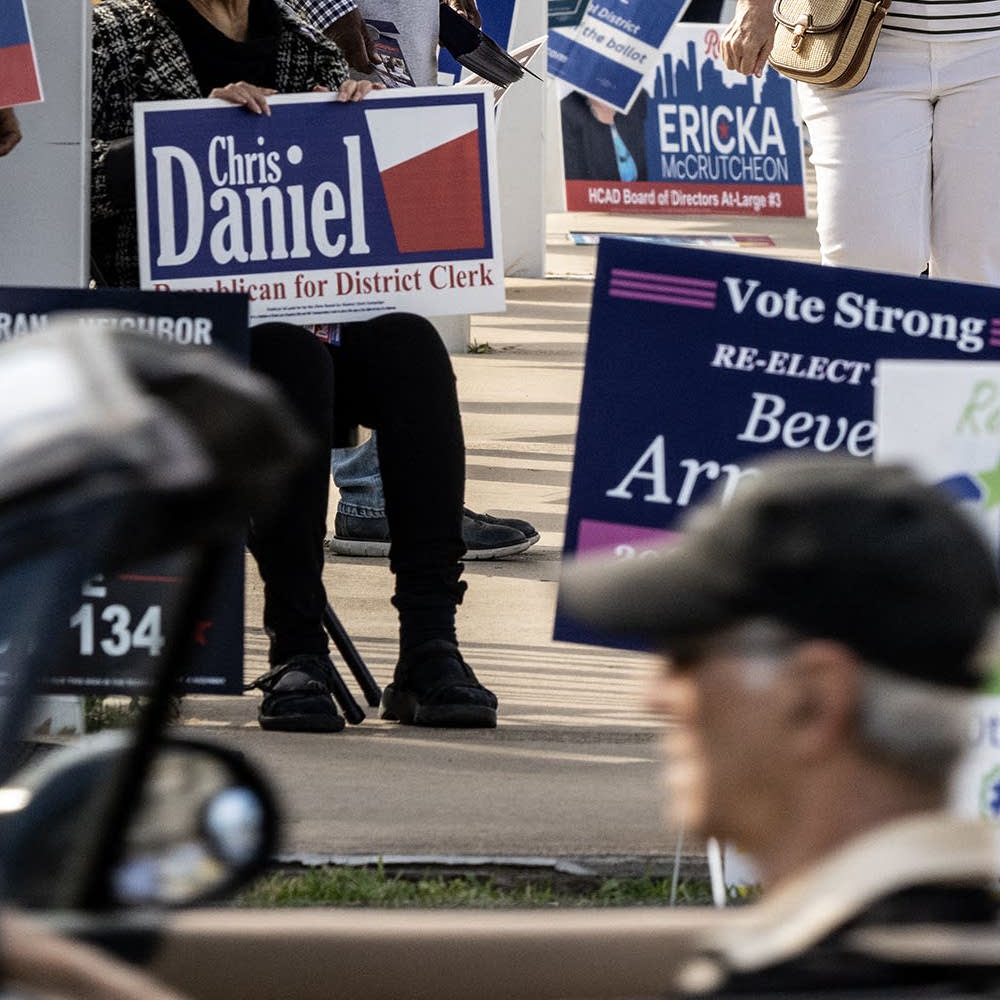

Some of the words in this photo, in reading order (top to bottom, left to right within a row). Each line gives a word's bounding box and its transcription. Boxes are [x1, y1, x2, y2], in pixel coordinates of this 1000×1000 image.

[582, 26, 605, 43] the
[606, 37, 648, 64] ballot
[597, 6, 641, 35] District
[658, 103, 786, 155] ERICKA
[208, 135, 281, 187] Chris
[661, 154, 790, 182] McCRUTCHEON
[151, 135, 370, 267] Daniel
[588, 188, 621, 205] HCAD
[623, 189, 655, 205] Board
[658, 189, 670, 205] of
[671, 190, 720, 207] Directors
[721, 190, 766, 211] At-Large
[767, 192, 782, 208] #3
[295, 274, 329, 298] for
[336, 267, 421, 297] District
[429, 263, 494, 290] Clerk
[723, 276, 826, 324] Vote
[833, 291, 986, 353] Strong
[710, 343, 871, 386] RE-ELECT
[736, 391, 878, 458] Beve
[605, 434, 760, 509] Arr
[69, 603, 165, 657] 134
